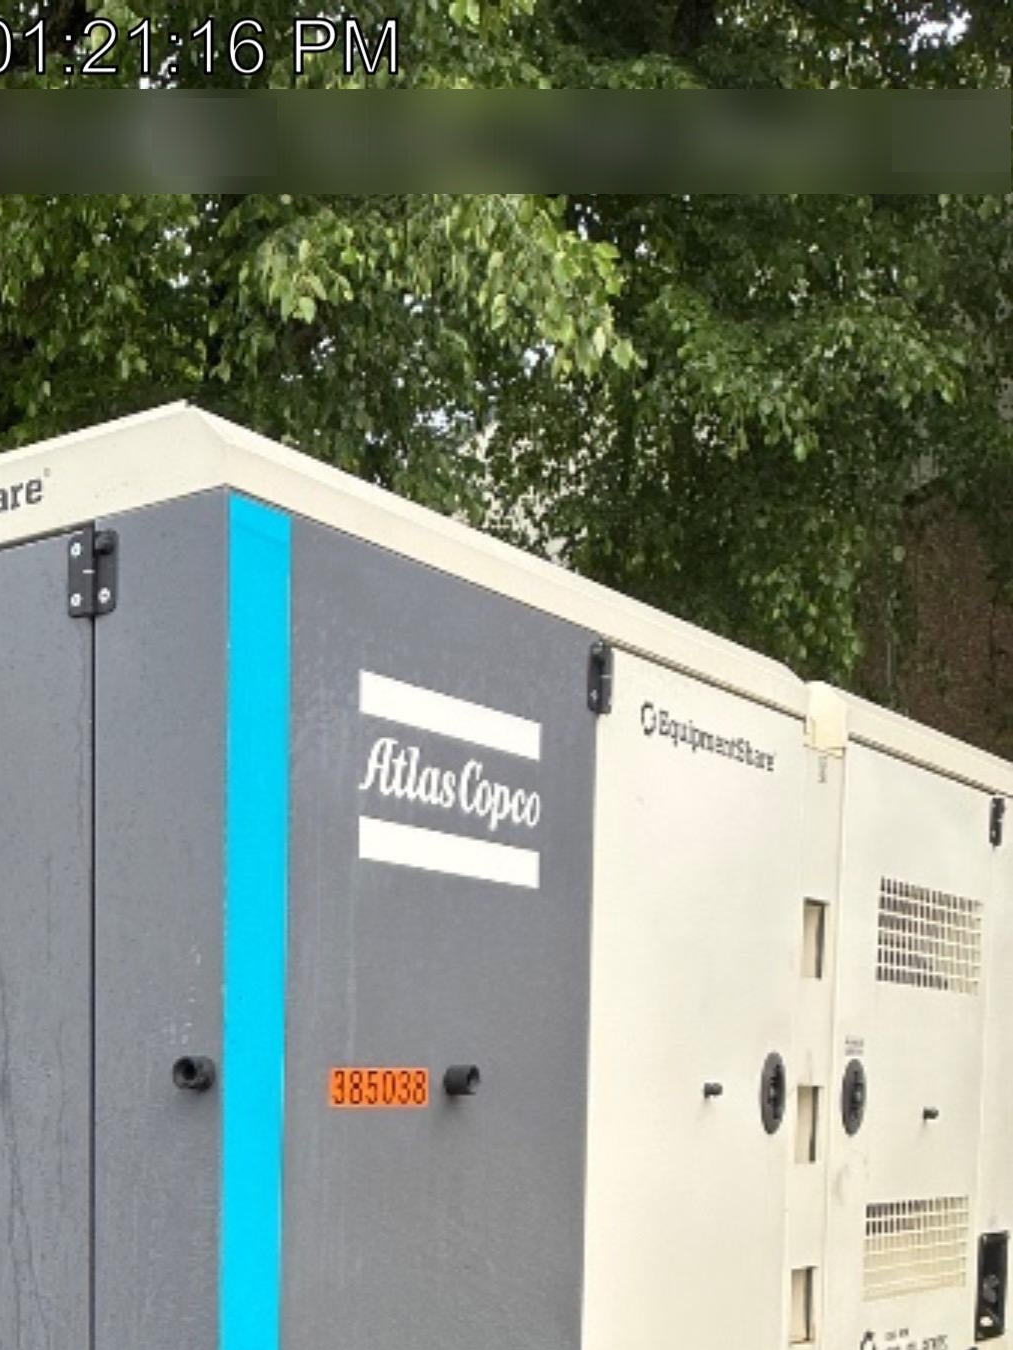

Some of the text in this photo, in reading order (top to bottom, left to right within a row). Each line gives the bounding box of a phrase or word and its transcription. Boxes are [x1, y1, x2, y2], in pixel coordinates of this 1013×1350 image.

[359, 737, 541, 830] Atlas Copco
[332, 1069, 428, 1105] 385038
